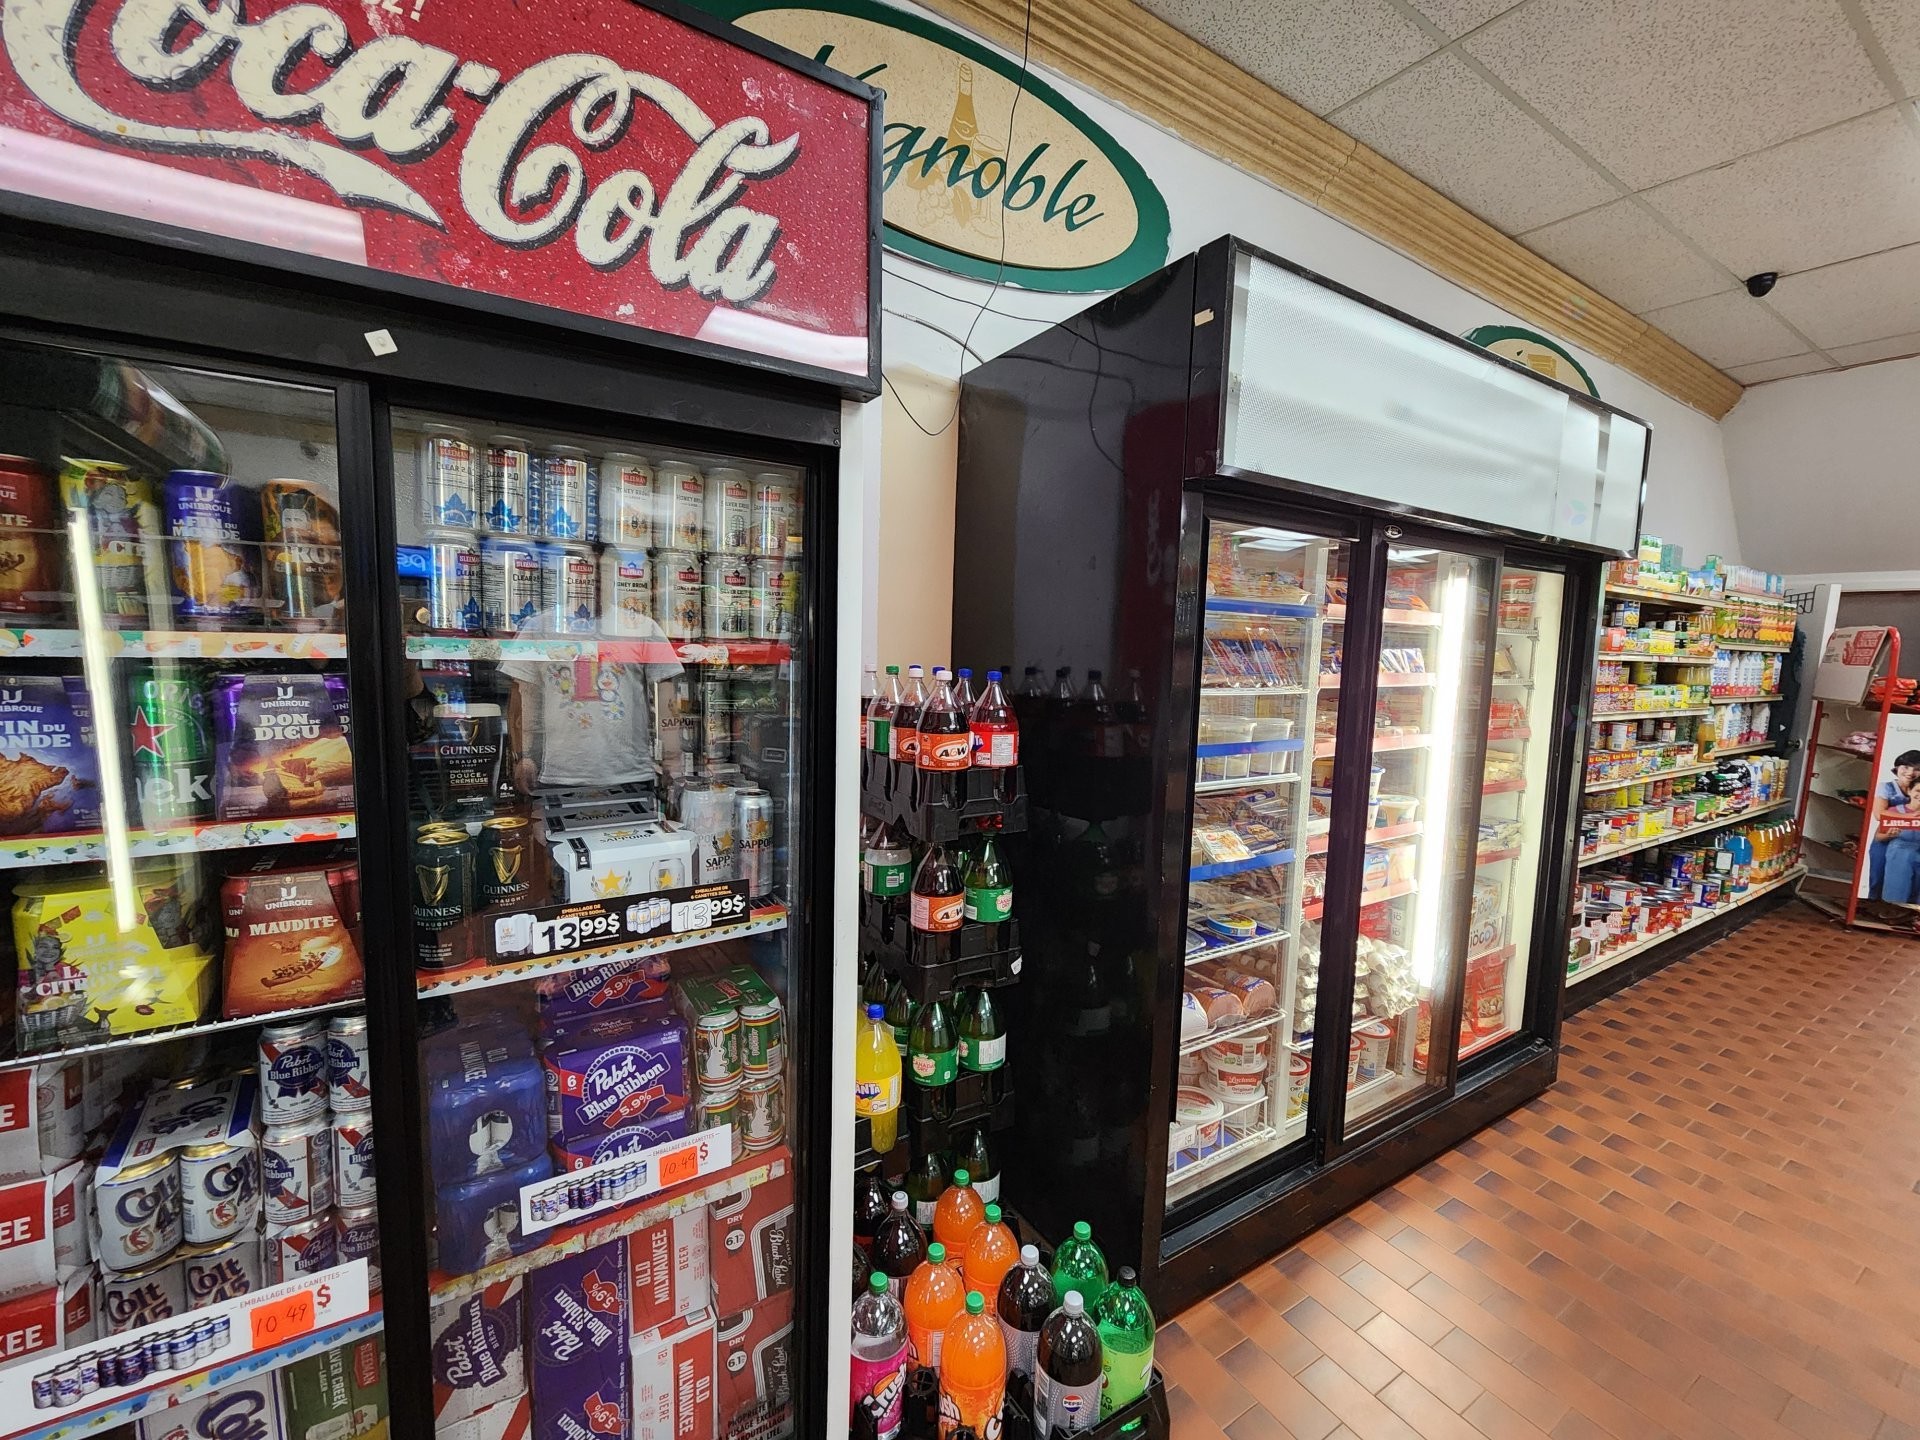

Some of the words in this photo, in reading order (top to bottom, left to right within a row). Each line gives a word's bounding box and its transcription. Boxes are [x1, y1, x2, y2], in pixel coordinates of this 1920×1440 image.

[260, 700, 311, 709] UNIBROUE
[43, 724, 66, 733] DU
[254, 725, 321, 741] DIEU
[260, 714, 309, 727] DON
[0, 734, 71, 748] ONDE
[440, 744, 497, 756] GUINNESS
[1883, 819, 1909, 828] Little
[482, 881, 530, 895] GUINNESS
[264, 900, 313, 910] UNIBROUE
[541, 920, 578, 950] 13
[570, 970, 602, 999] Blue
[270, 1067, 292, 1081] Blue
[291, 1060, 324, 1077] Ribbon
[280, 1051, 313, 1069] Pabst
[567, 1075, 577, 1087] 6
[588, 1054, 637, 1096] Pabst
[855, 1083, 882, 1095] ANTA
[582, 1091, 619, 1121] Blue
[613, 1061, 665, 1100] Ribbon
[574, 1157, 584, 1169] 6
[727, 1213, 744, 1225] DRY
[679, 1246, 689, 1271] BEER
[769, 1229, 785, 1264] Black
[186, 1256, 245, 1300] Colt
[635, 1260, 651, 1288] OLD
[652, 1229, 670, 1305] MILWAUKEE
[772, 1258, 789, 1289] Label
[106, 1281, 166, 1327] Colt
[239, 1287, 286, 1310] EMBALLAGE
[286, 1284, 297, 1295] DE
[303, 1270, 342, 1289] CANETTES
[553, 1289, 588, 1333] Ribbon
[541, 1320, 584, 1362] Pabst
[586, 1313, 613, 1348] Blue
[729, 1334, 747, 1347] DRY
[328, 1345, 344, 1375] ILVER
[359, 1342, 377, 1387] SLEEMAN
[443, 1335, 475, 1386] Pabst
[478, 1350, 501, 1385] Blue
[318, 1368, 328, 1393] LAGER
[332, 1374, 348, 1411] CREEK
[696, 1375, 710, 1404] OLD
[679, 1358, 694, 1437] MILWAUKEE
